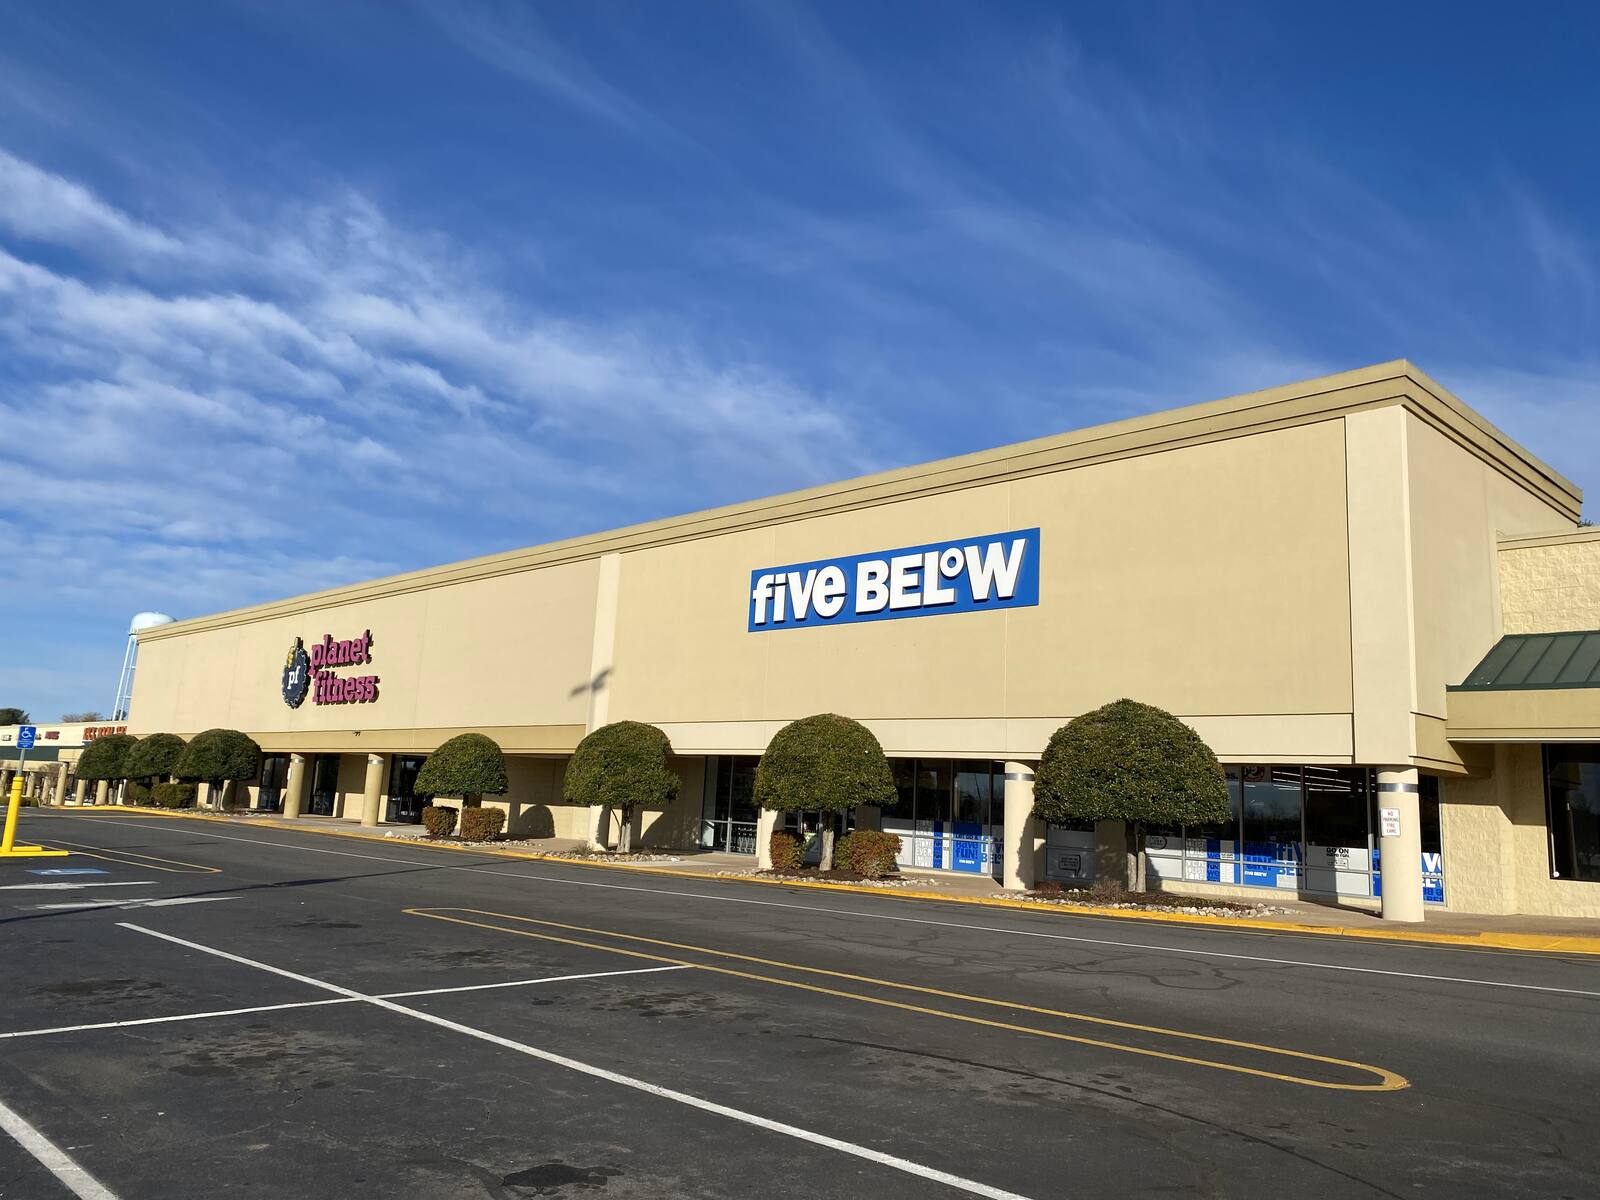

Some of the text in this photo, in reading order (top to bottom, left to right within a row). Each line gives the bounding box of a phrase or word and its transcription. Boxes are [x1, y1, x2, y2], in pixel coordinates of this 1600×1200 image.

[752, 565, 848, 624] five
[308, 629, 371, 675] planet
[312, 671, 379, 704] fitness
